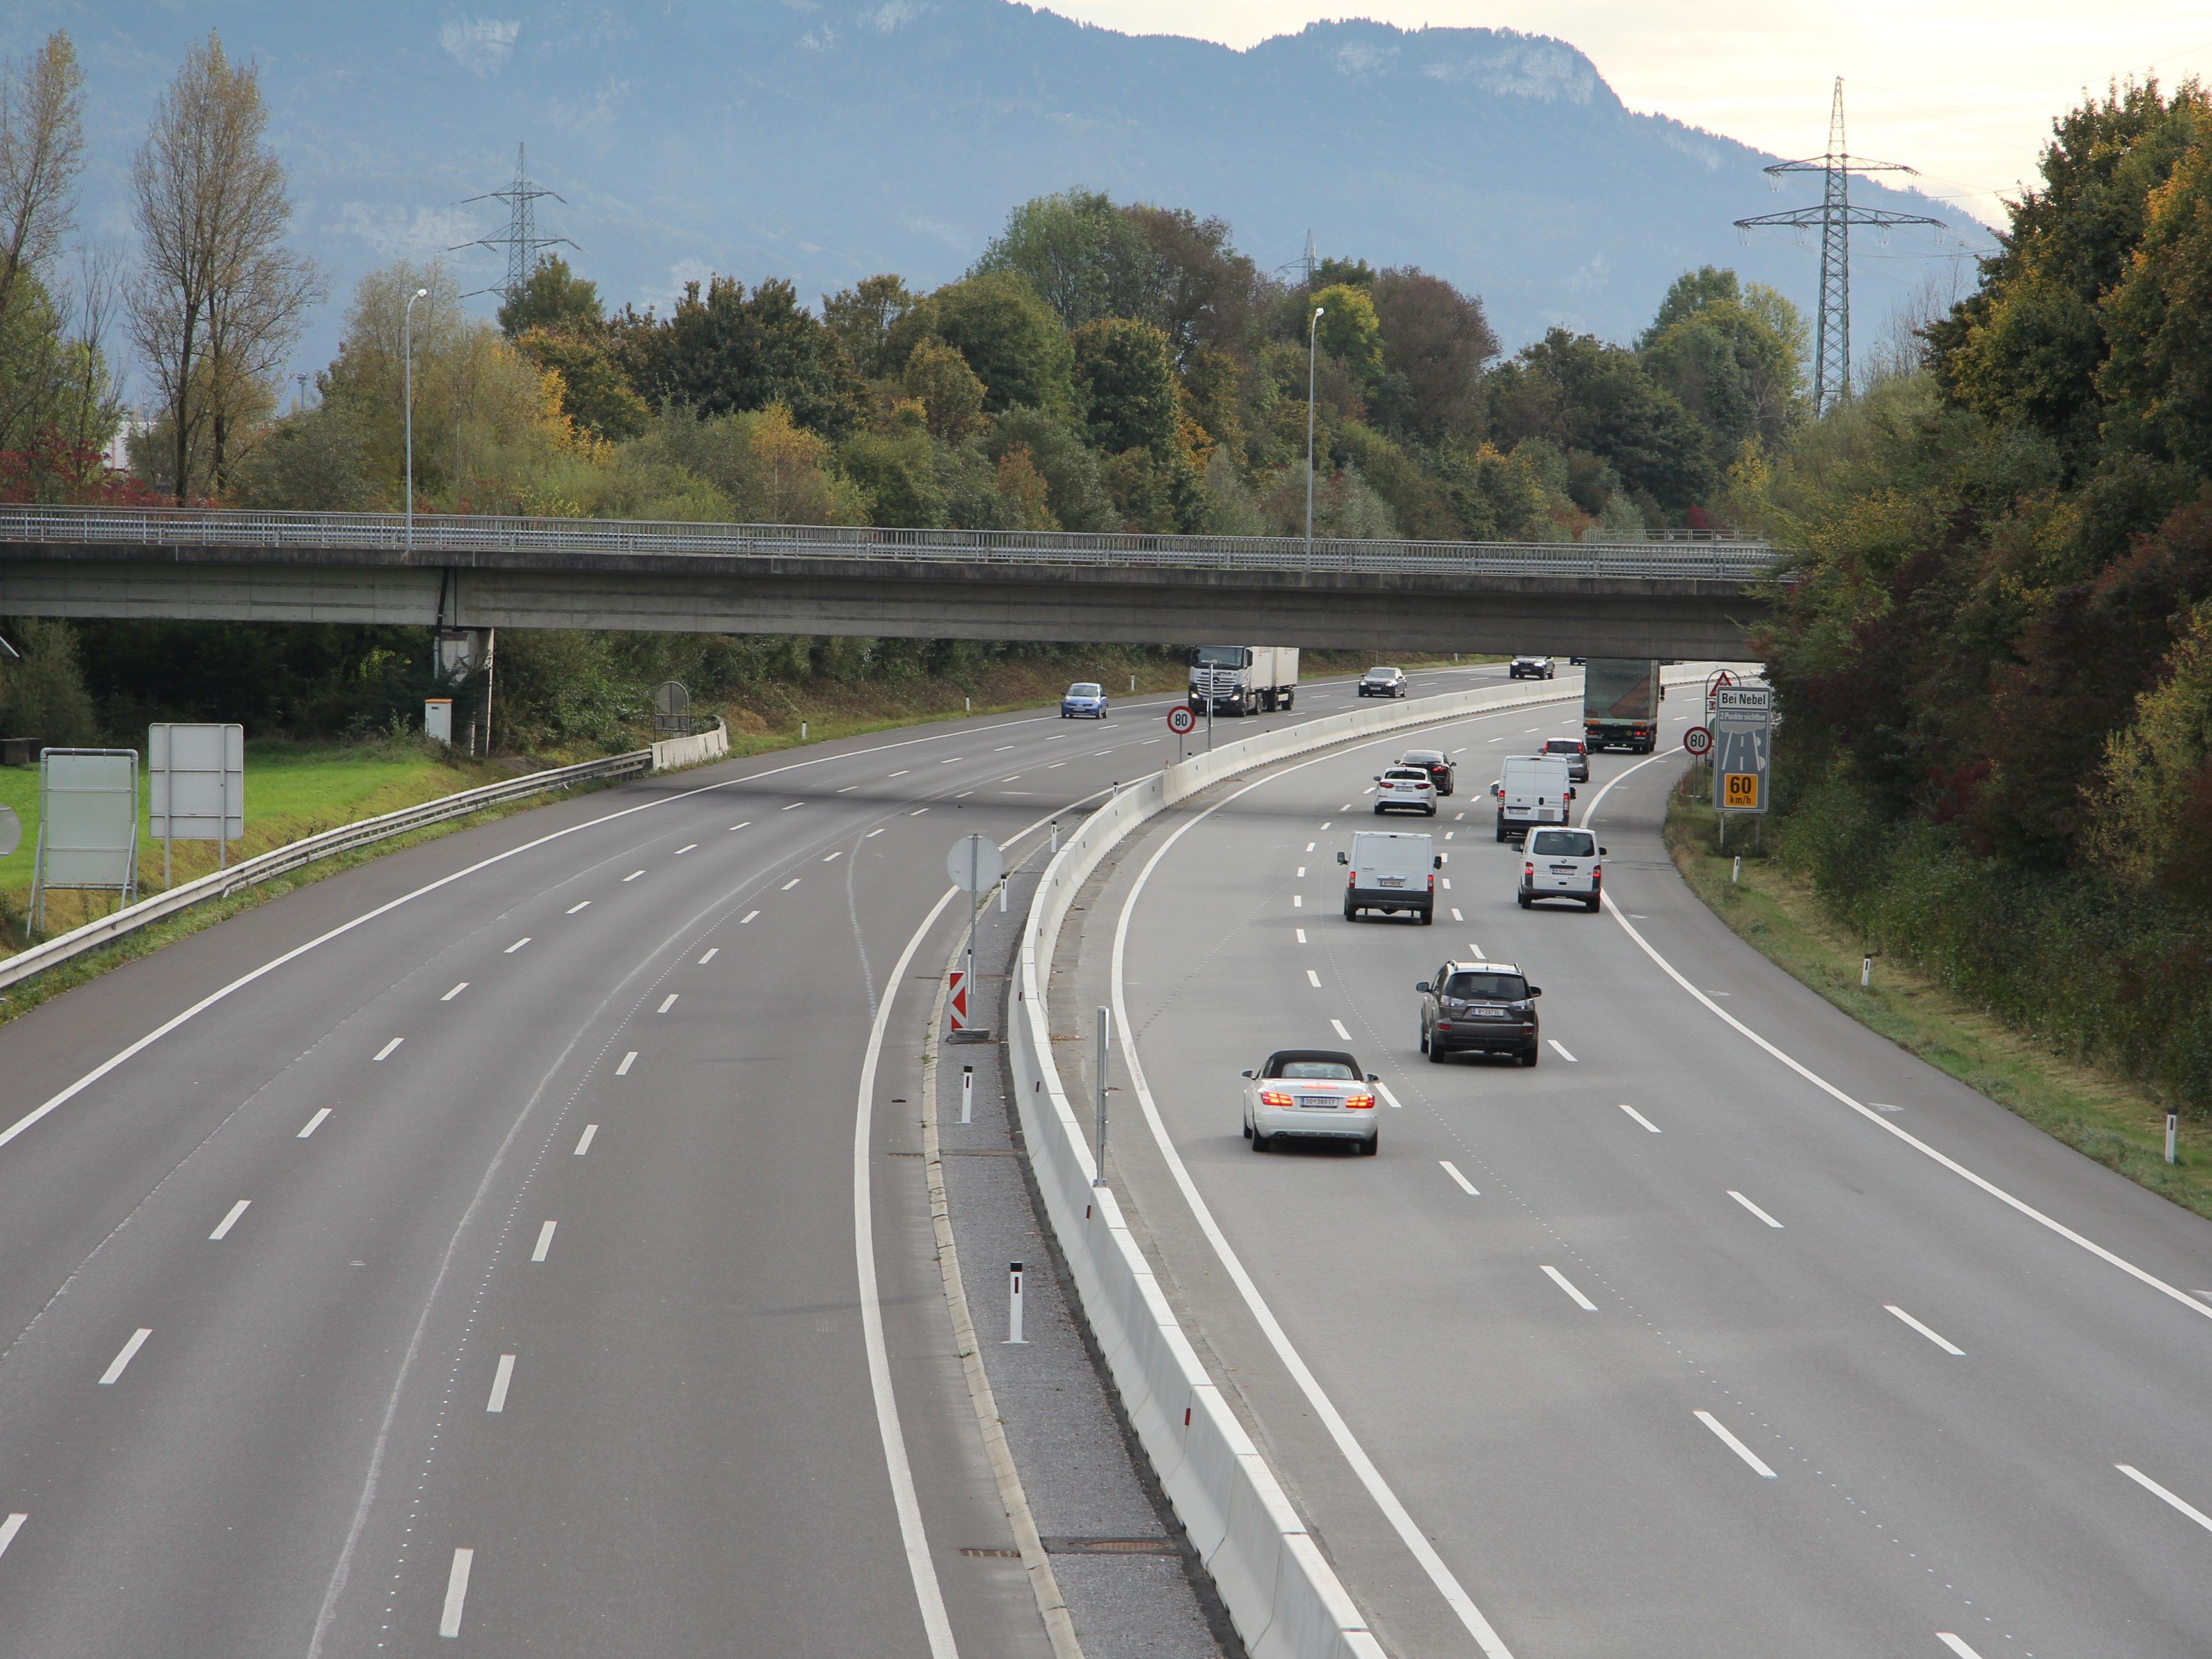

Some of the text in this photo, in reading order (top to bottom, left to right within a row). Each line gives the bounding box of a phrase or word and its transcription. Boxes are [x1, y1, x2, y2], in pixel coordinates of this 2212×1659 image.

[1722, 693, 1765, 705] Bei Nebel
[1175, 714, 1187, 726] 80
[1691, 734, 1705, 747] 80
[1730, 776, 1751, 794] 60
[1730, 796, 1751, 806] km/h
